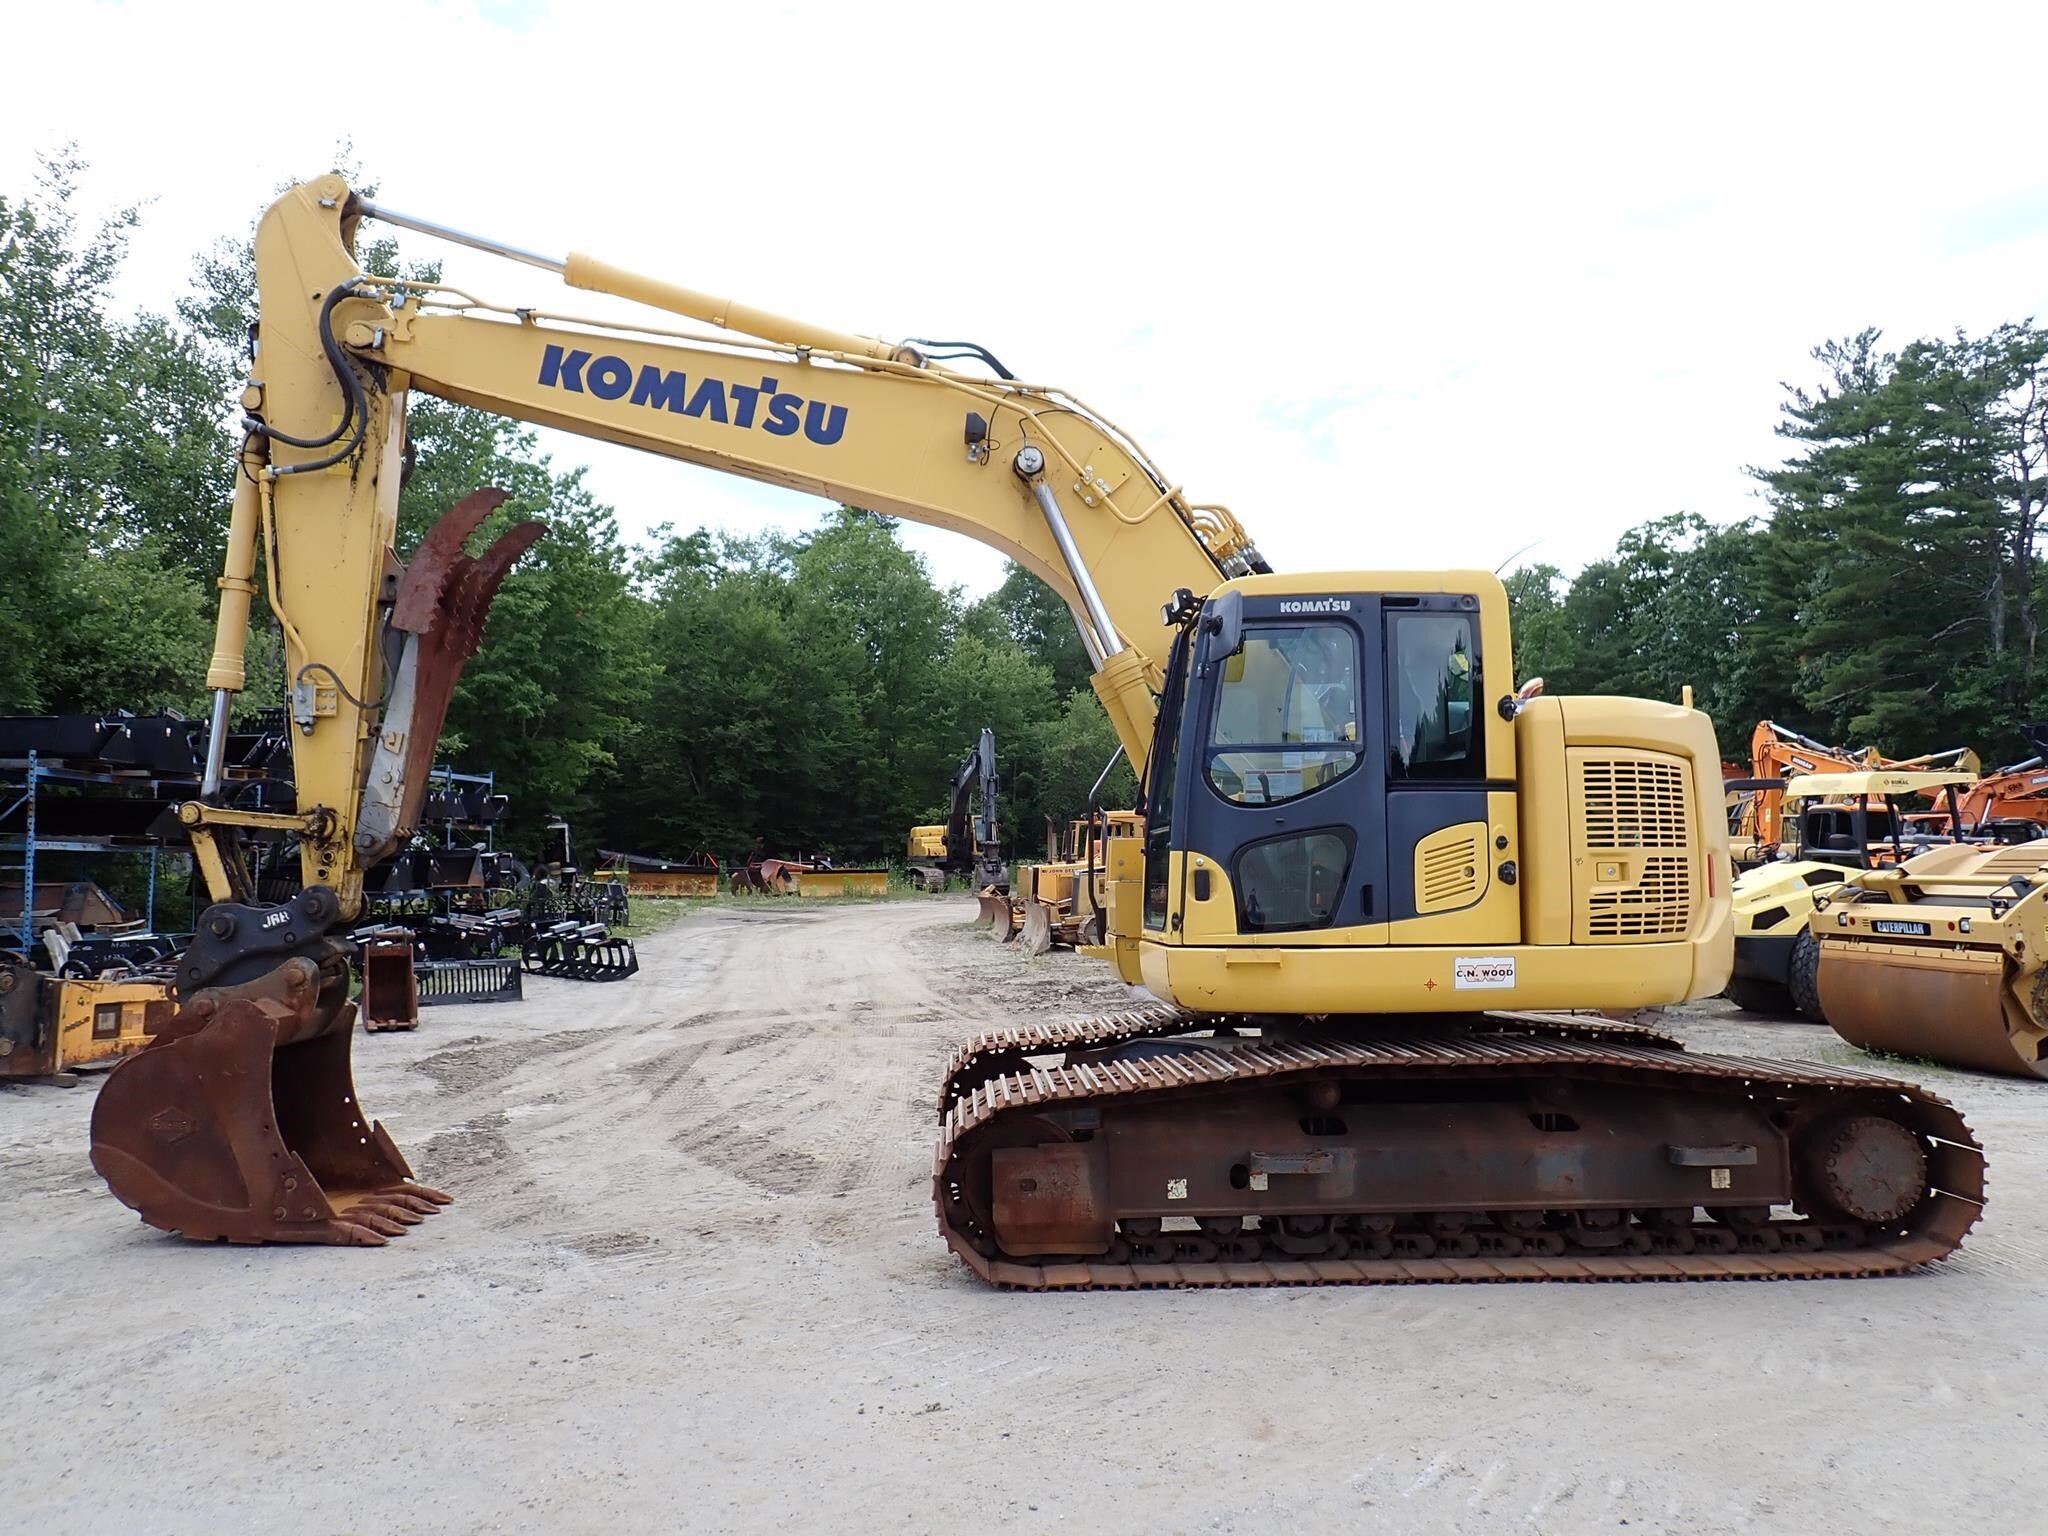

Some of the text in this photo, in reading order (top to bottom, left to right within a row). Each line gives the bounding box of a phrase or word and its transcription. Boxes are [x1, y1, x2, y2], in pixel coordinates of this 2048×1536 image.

[537, 344, 849, 446] KOMATSU
[1280, 598, 1351, 613] KOMATSU
[1876, 921, 1925, 935] CATERPILLAR
[1456, 969, 1514, 978] C.N. WOOD
